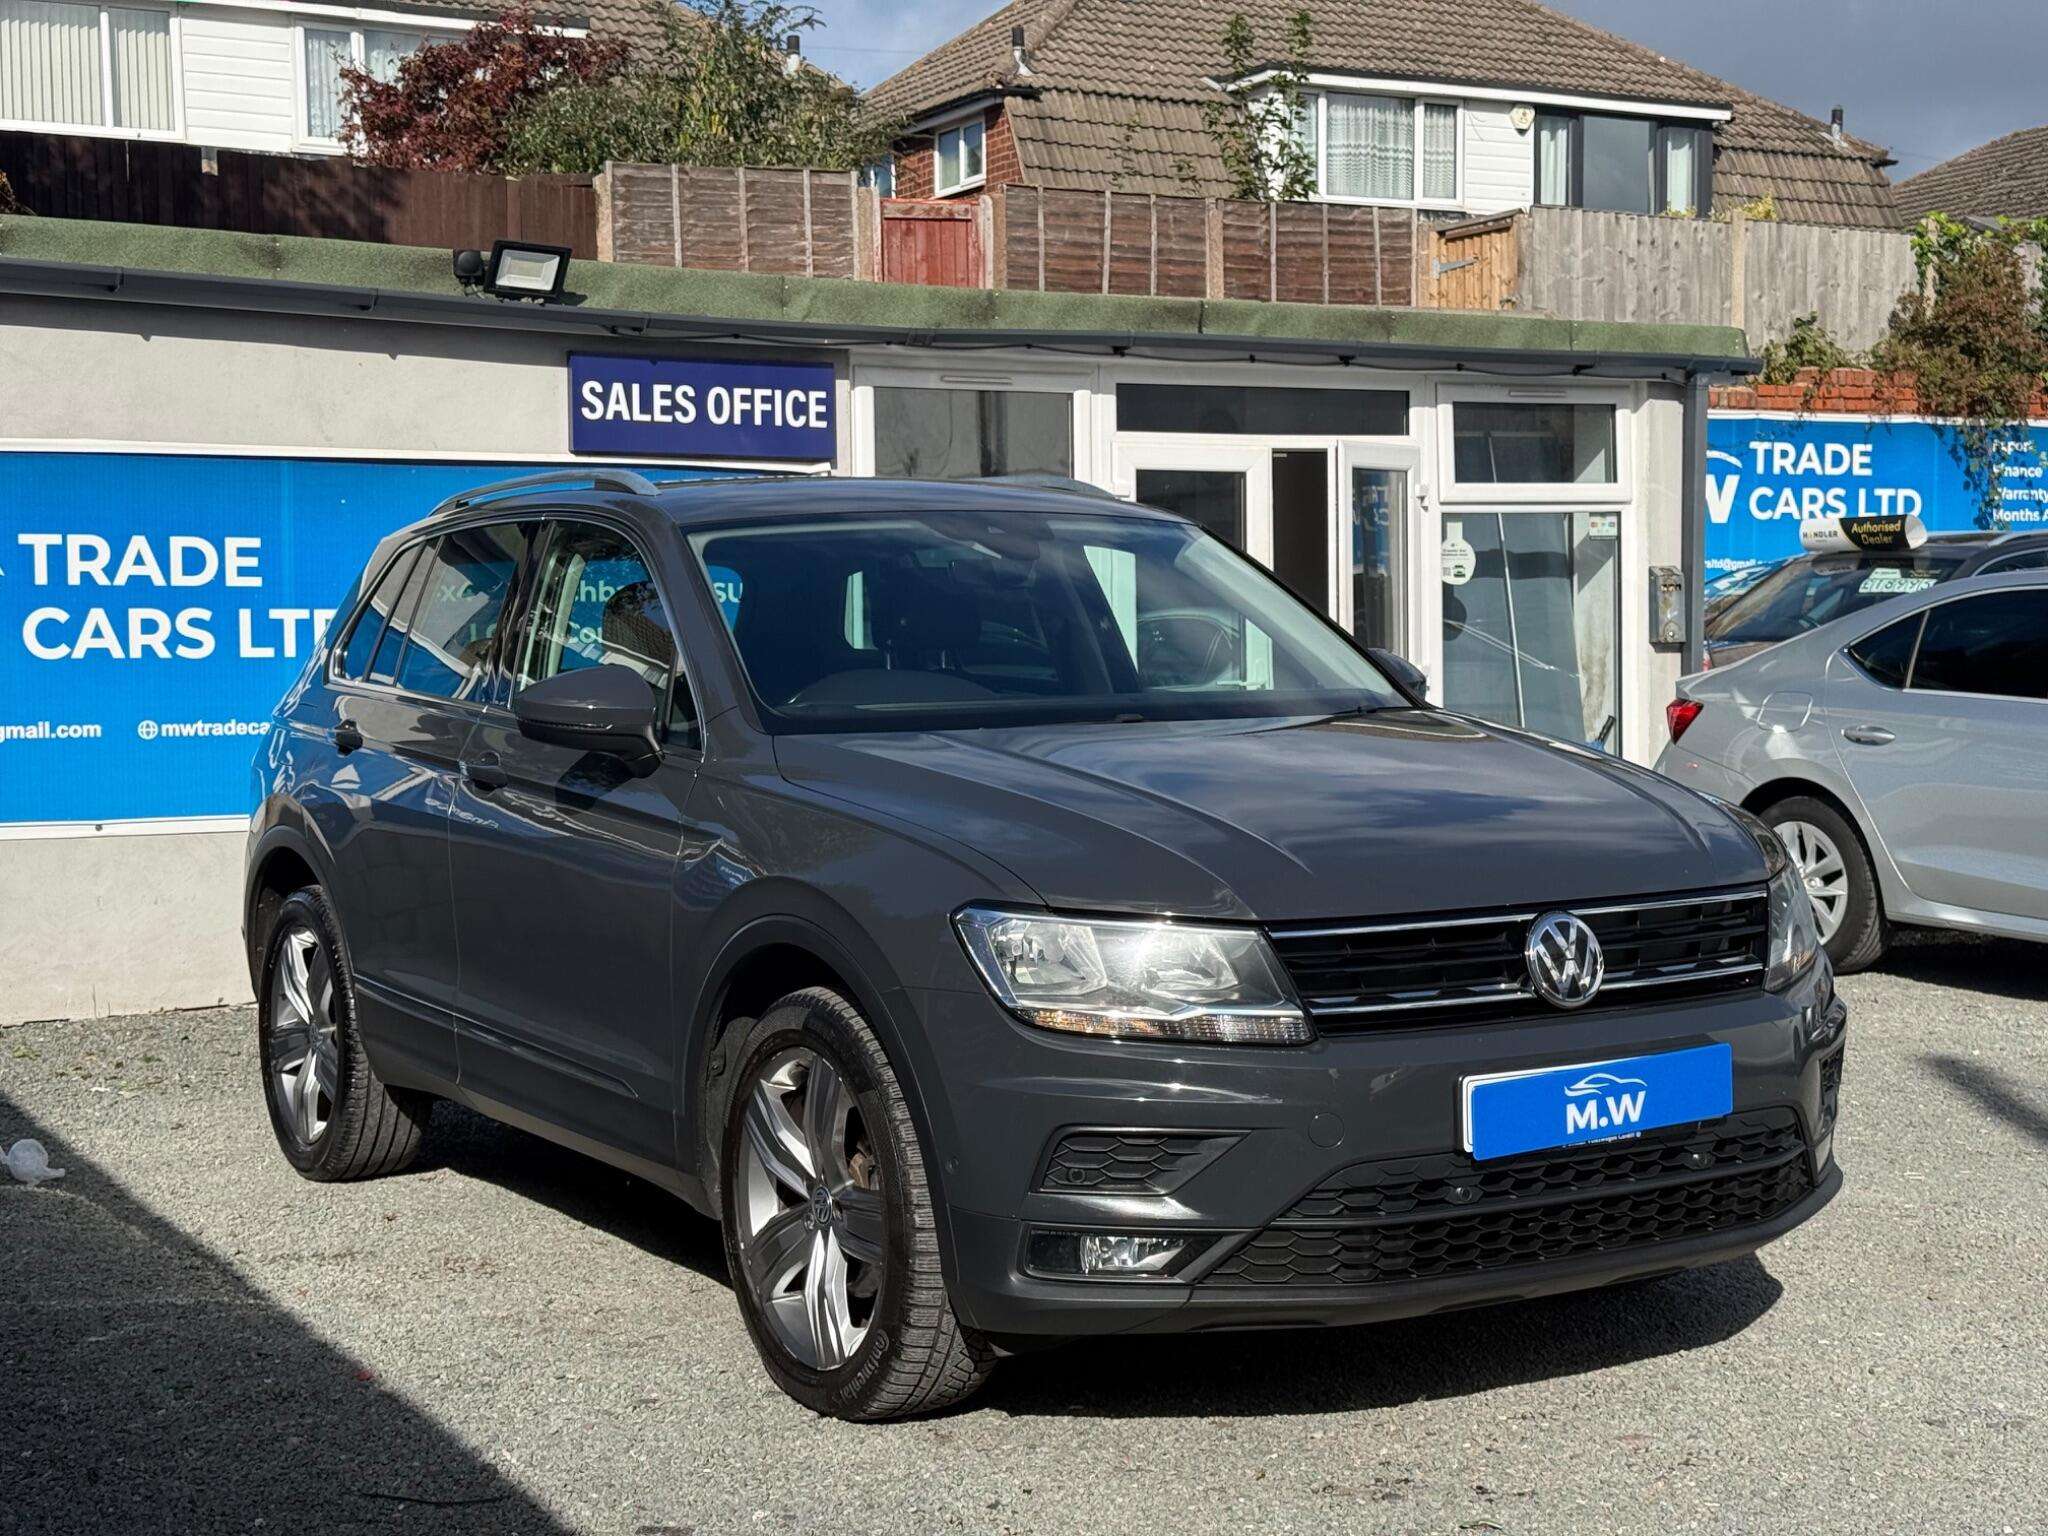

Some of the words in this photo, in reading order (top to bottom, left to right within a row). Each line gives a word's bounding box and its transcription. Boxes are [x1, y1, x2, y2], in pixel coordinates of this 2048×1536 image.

[581, 381, 697, 424] SALES
[707, 386, 828, 428] OFFICE
[1749, 441, 1873, 477] TRADE
[1749, 486, 1847, 520] CARS
[1858, 487, 1922, 518] LTD
[1852, 520, 1902, 534] Authorised
[1861, 534, 1894, 545] Dealer
[18, 533, 263, 588] TRADE
[22, 606, 216, 660] CARS
[1565, 1090, 1647, 1135] M.W
